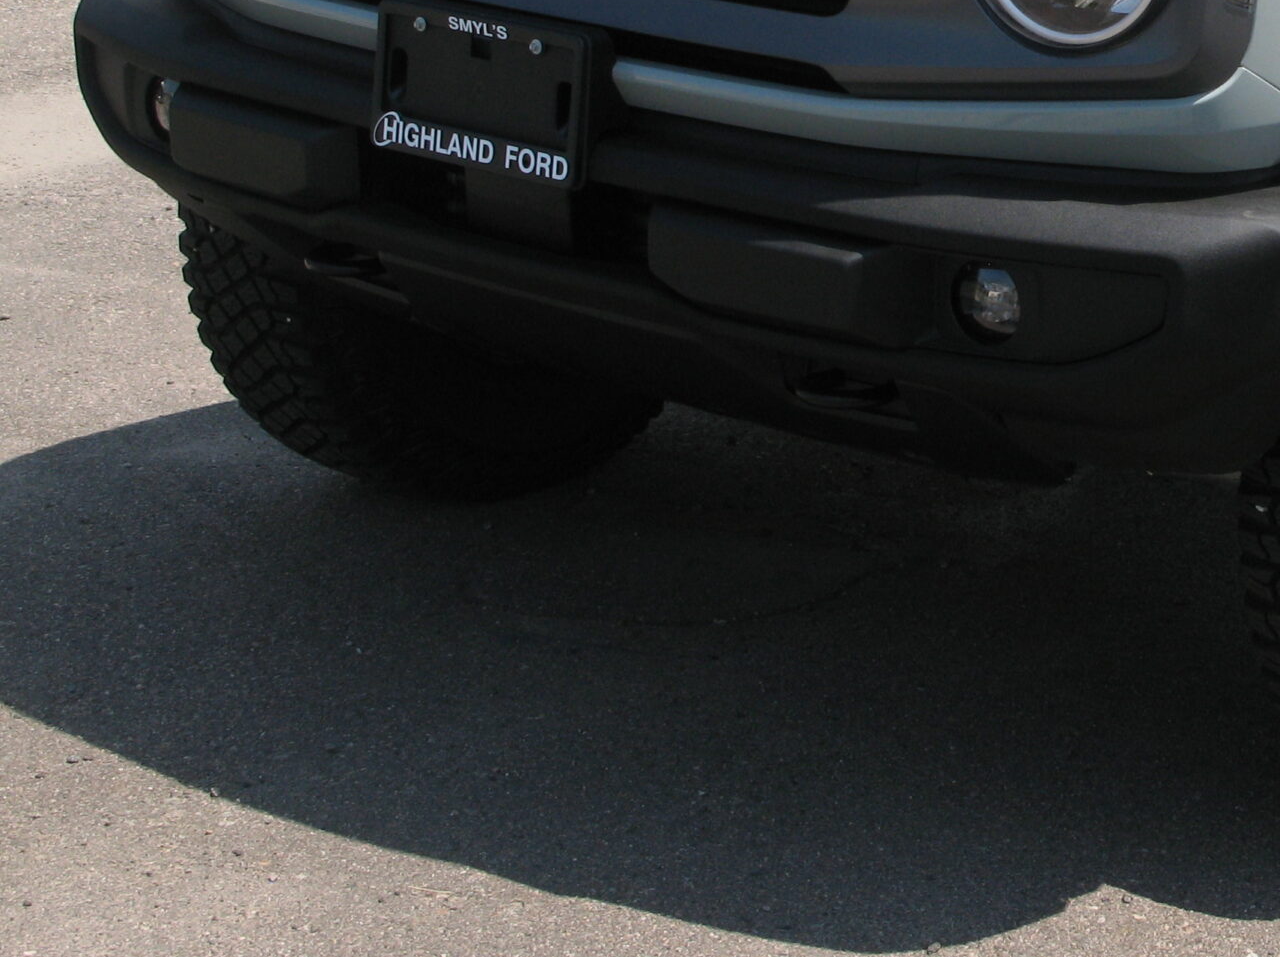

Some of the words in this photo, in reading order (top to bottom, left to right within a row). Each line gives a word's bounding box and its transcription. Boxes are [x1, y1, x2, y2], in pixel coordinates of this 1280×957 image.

[448, 15, 508, 41] SMYL'S
[377, 113, 495, 165] HIGHLAND
[505, 143, 570, 182] FORD
